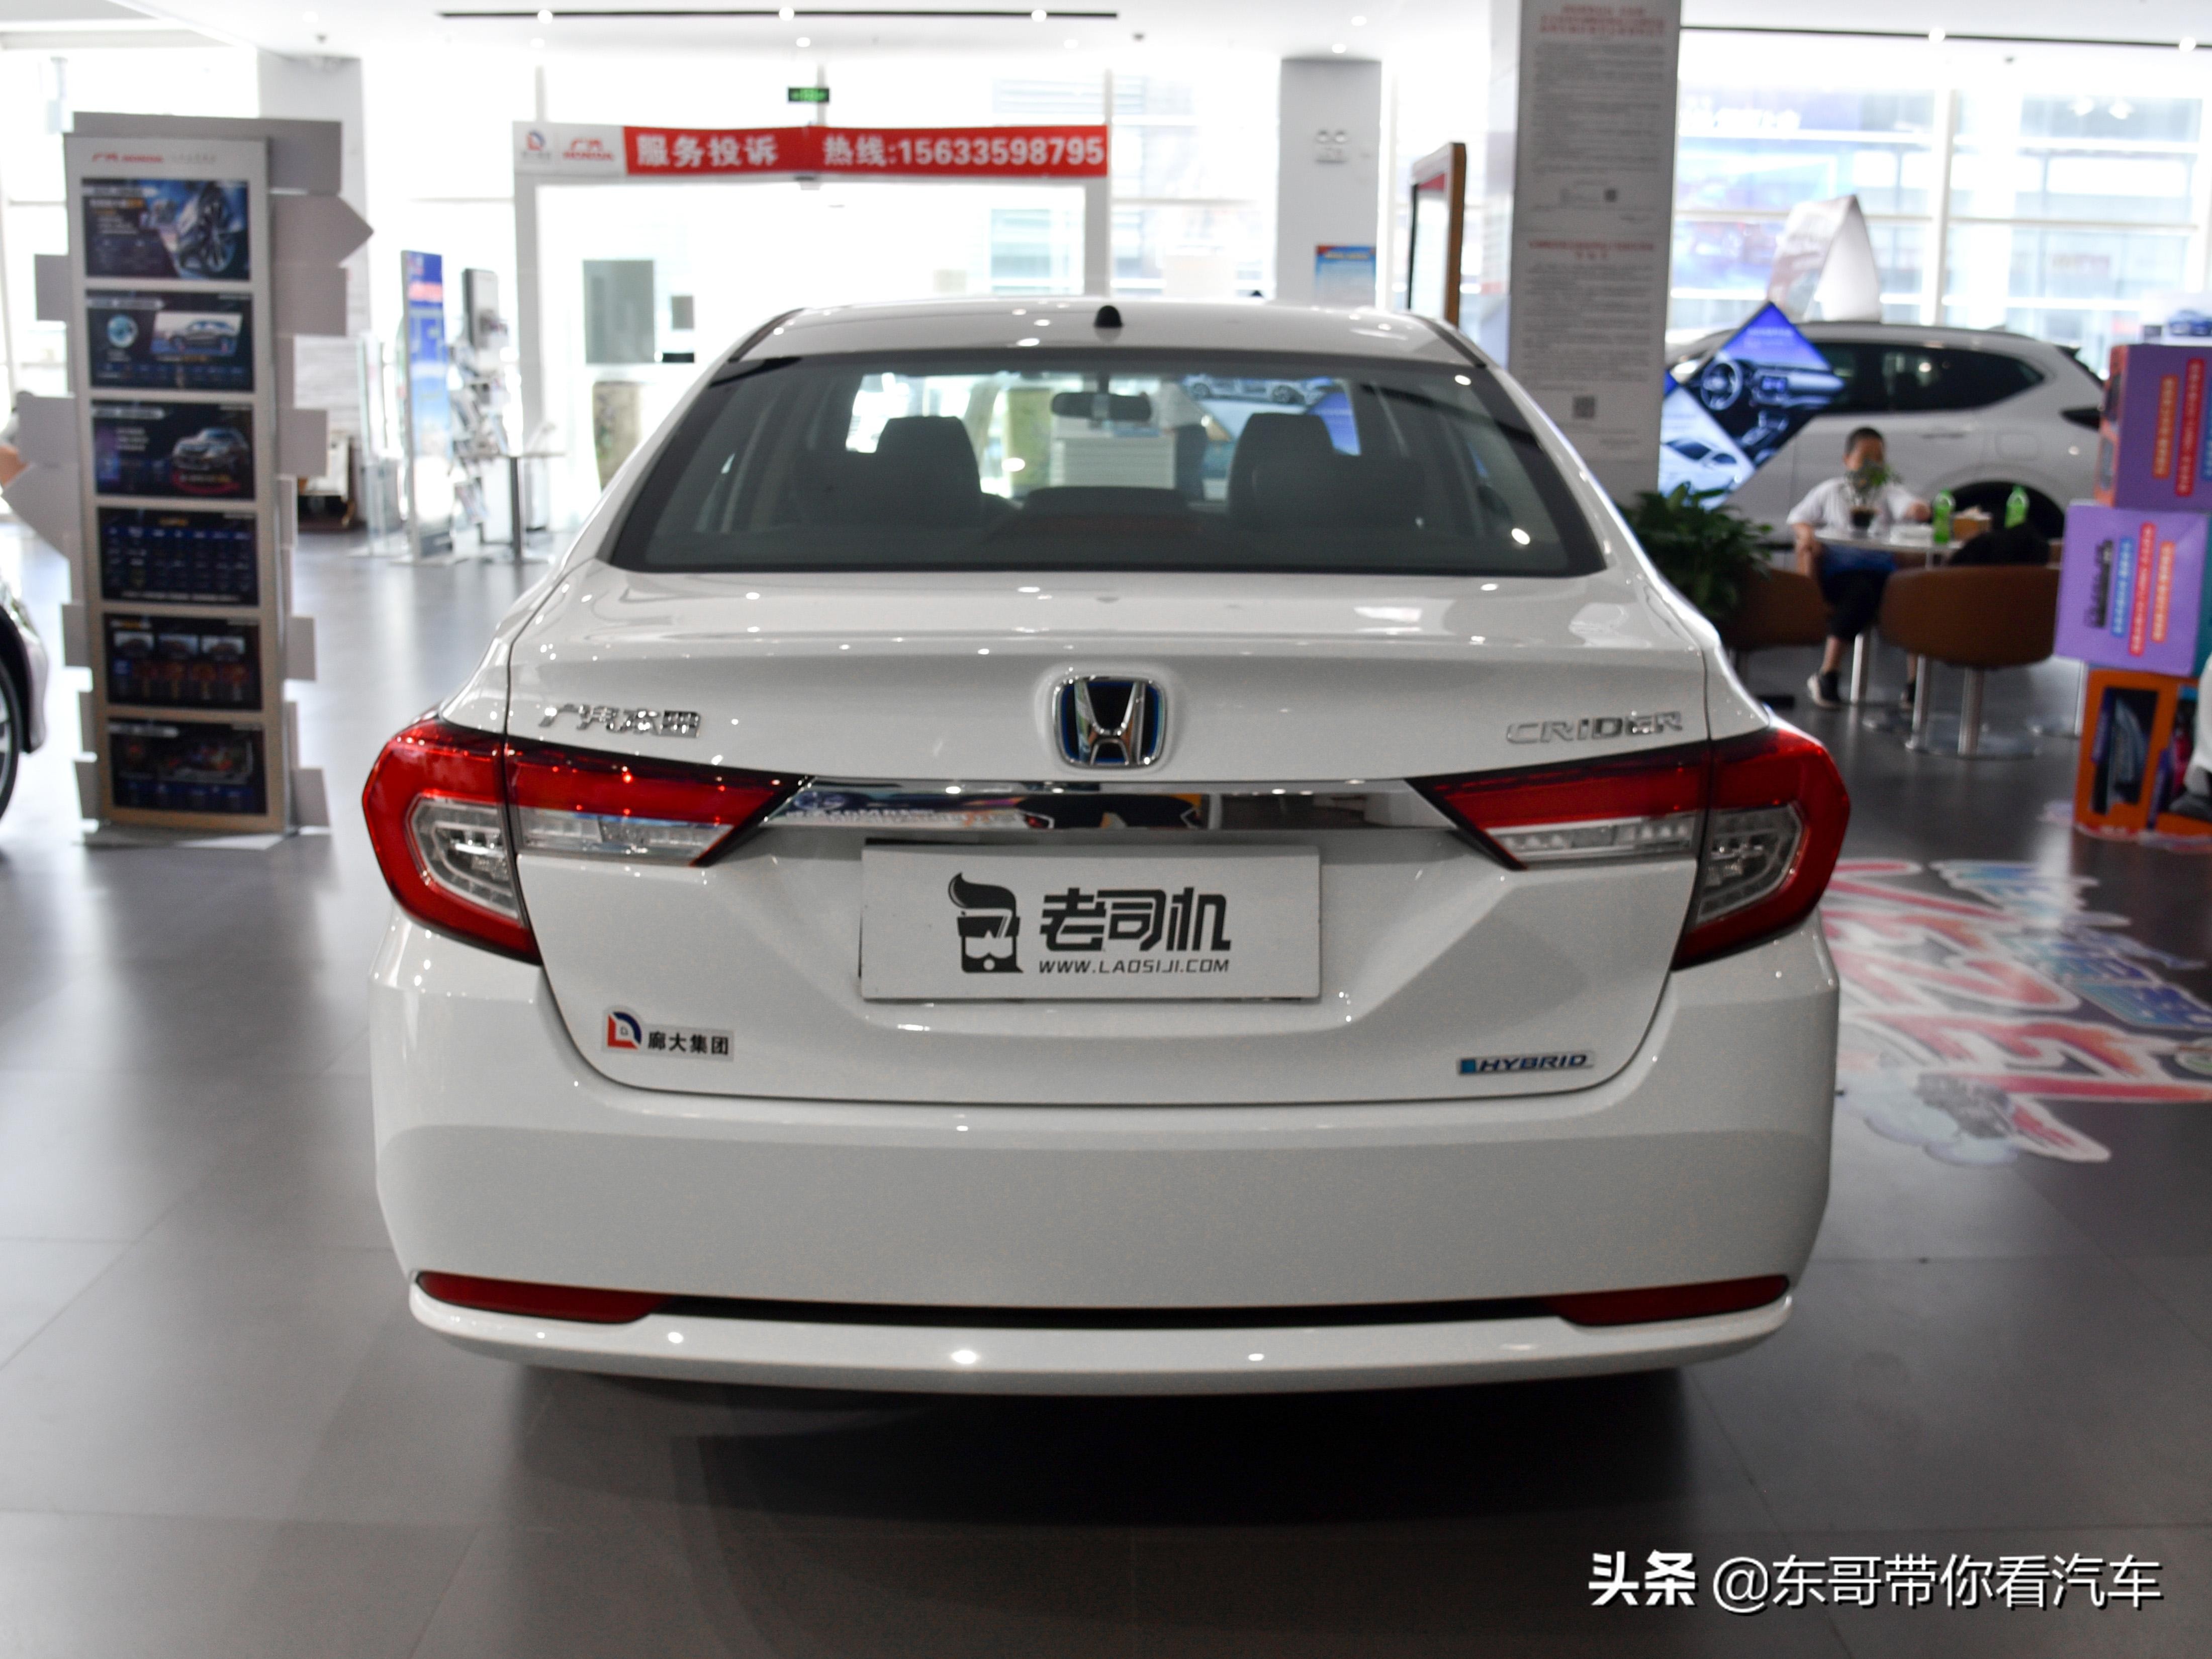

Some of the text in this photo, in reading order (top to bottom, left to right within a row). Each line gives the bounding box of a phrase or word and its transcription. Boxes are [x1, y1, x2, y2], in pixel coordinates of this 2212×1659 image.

[636, 134, 778, 167] 服务投诉
[822, 133, 1104, 167] 热线:15633598795
[1506, 711, 1683, 744] CRIDER
[1039, 887, 1231, 952] 老司机
[1039, 958, 1230, 974] WWW.LAOSIJI.COM
[648, 1031, 729, 1055] 廊大集团
[1479, 1054, 1587, 1071] HYBRID
